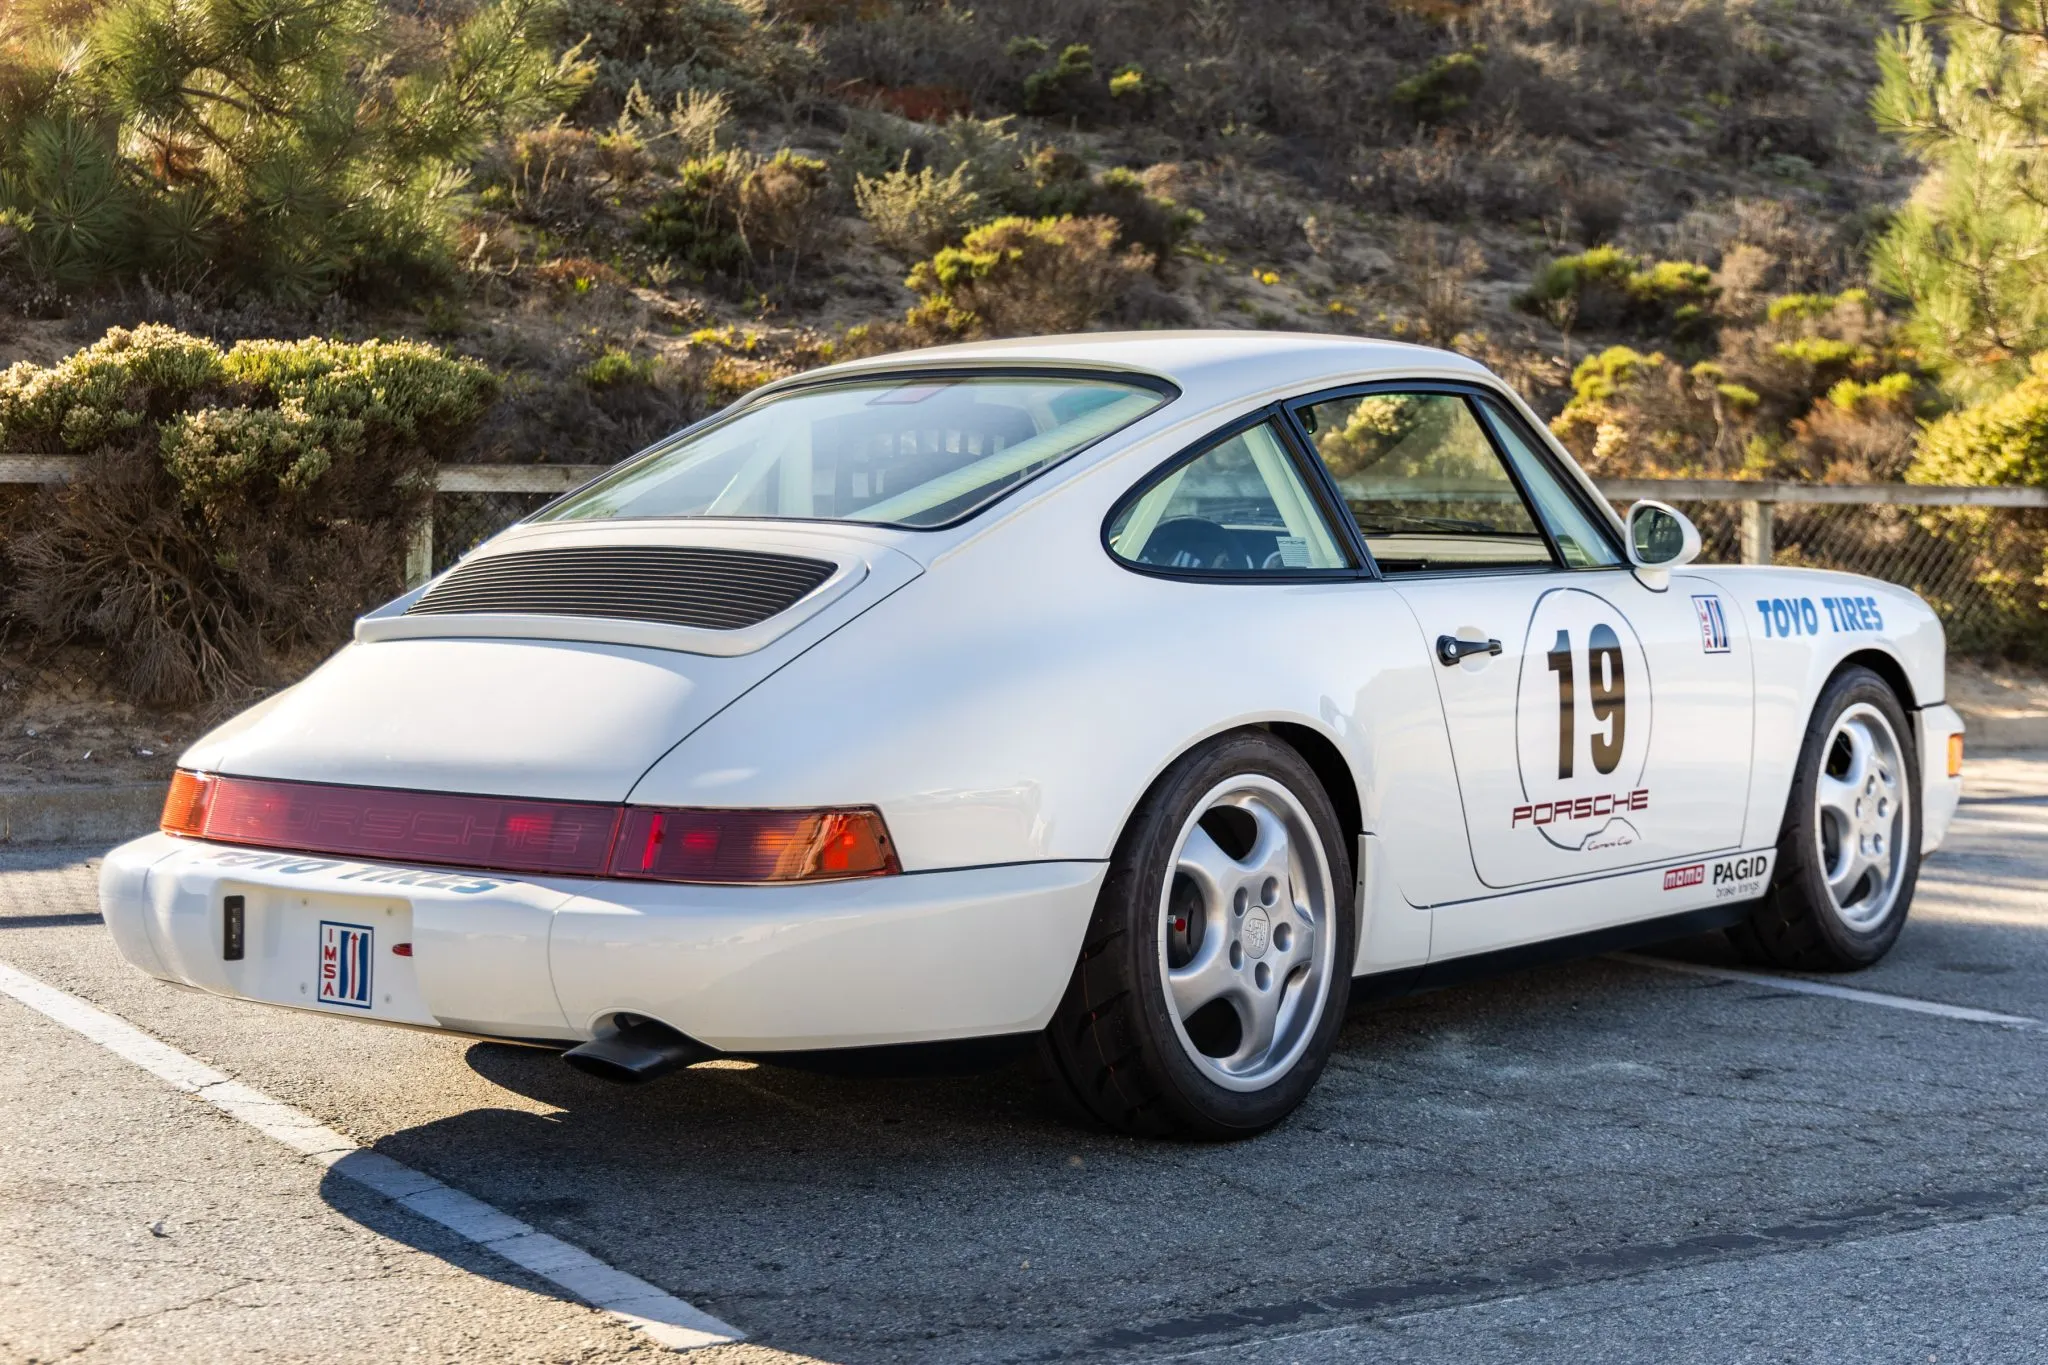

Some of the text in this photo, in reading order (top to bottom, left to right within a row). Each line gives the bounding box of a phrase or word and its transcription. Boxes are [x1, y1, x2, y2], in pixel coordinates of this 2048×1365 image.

[1756, 597, 1883, 638] TOYO TIRES
[1547, 623, 1626, 780] 19
[230, 796, 583, 855] ORSCHE
[1512, 789, 1649, 829] PORSCHE
[1713, 856, 1767, 885] PAGID
[323, 928, 338, 997] IMSA
